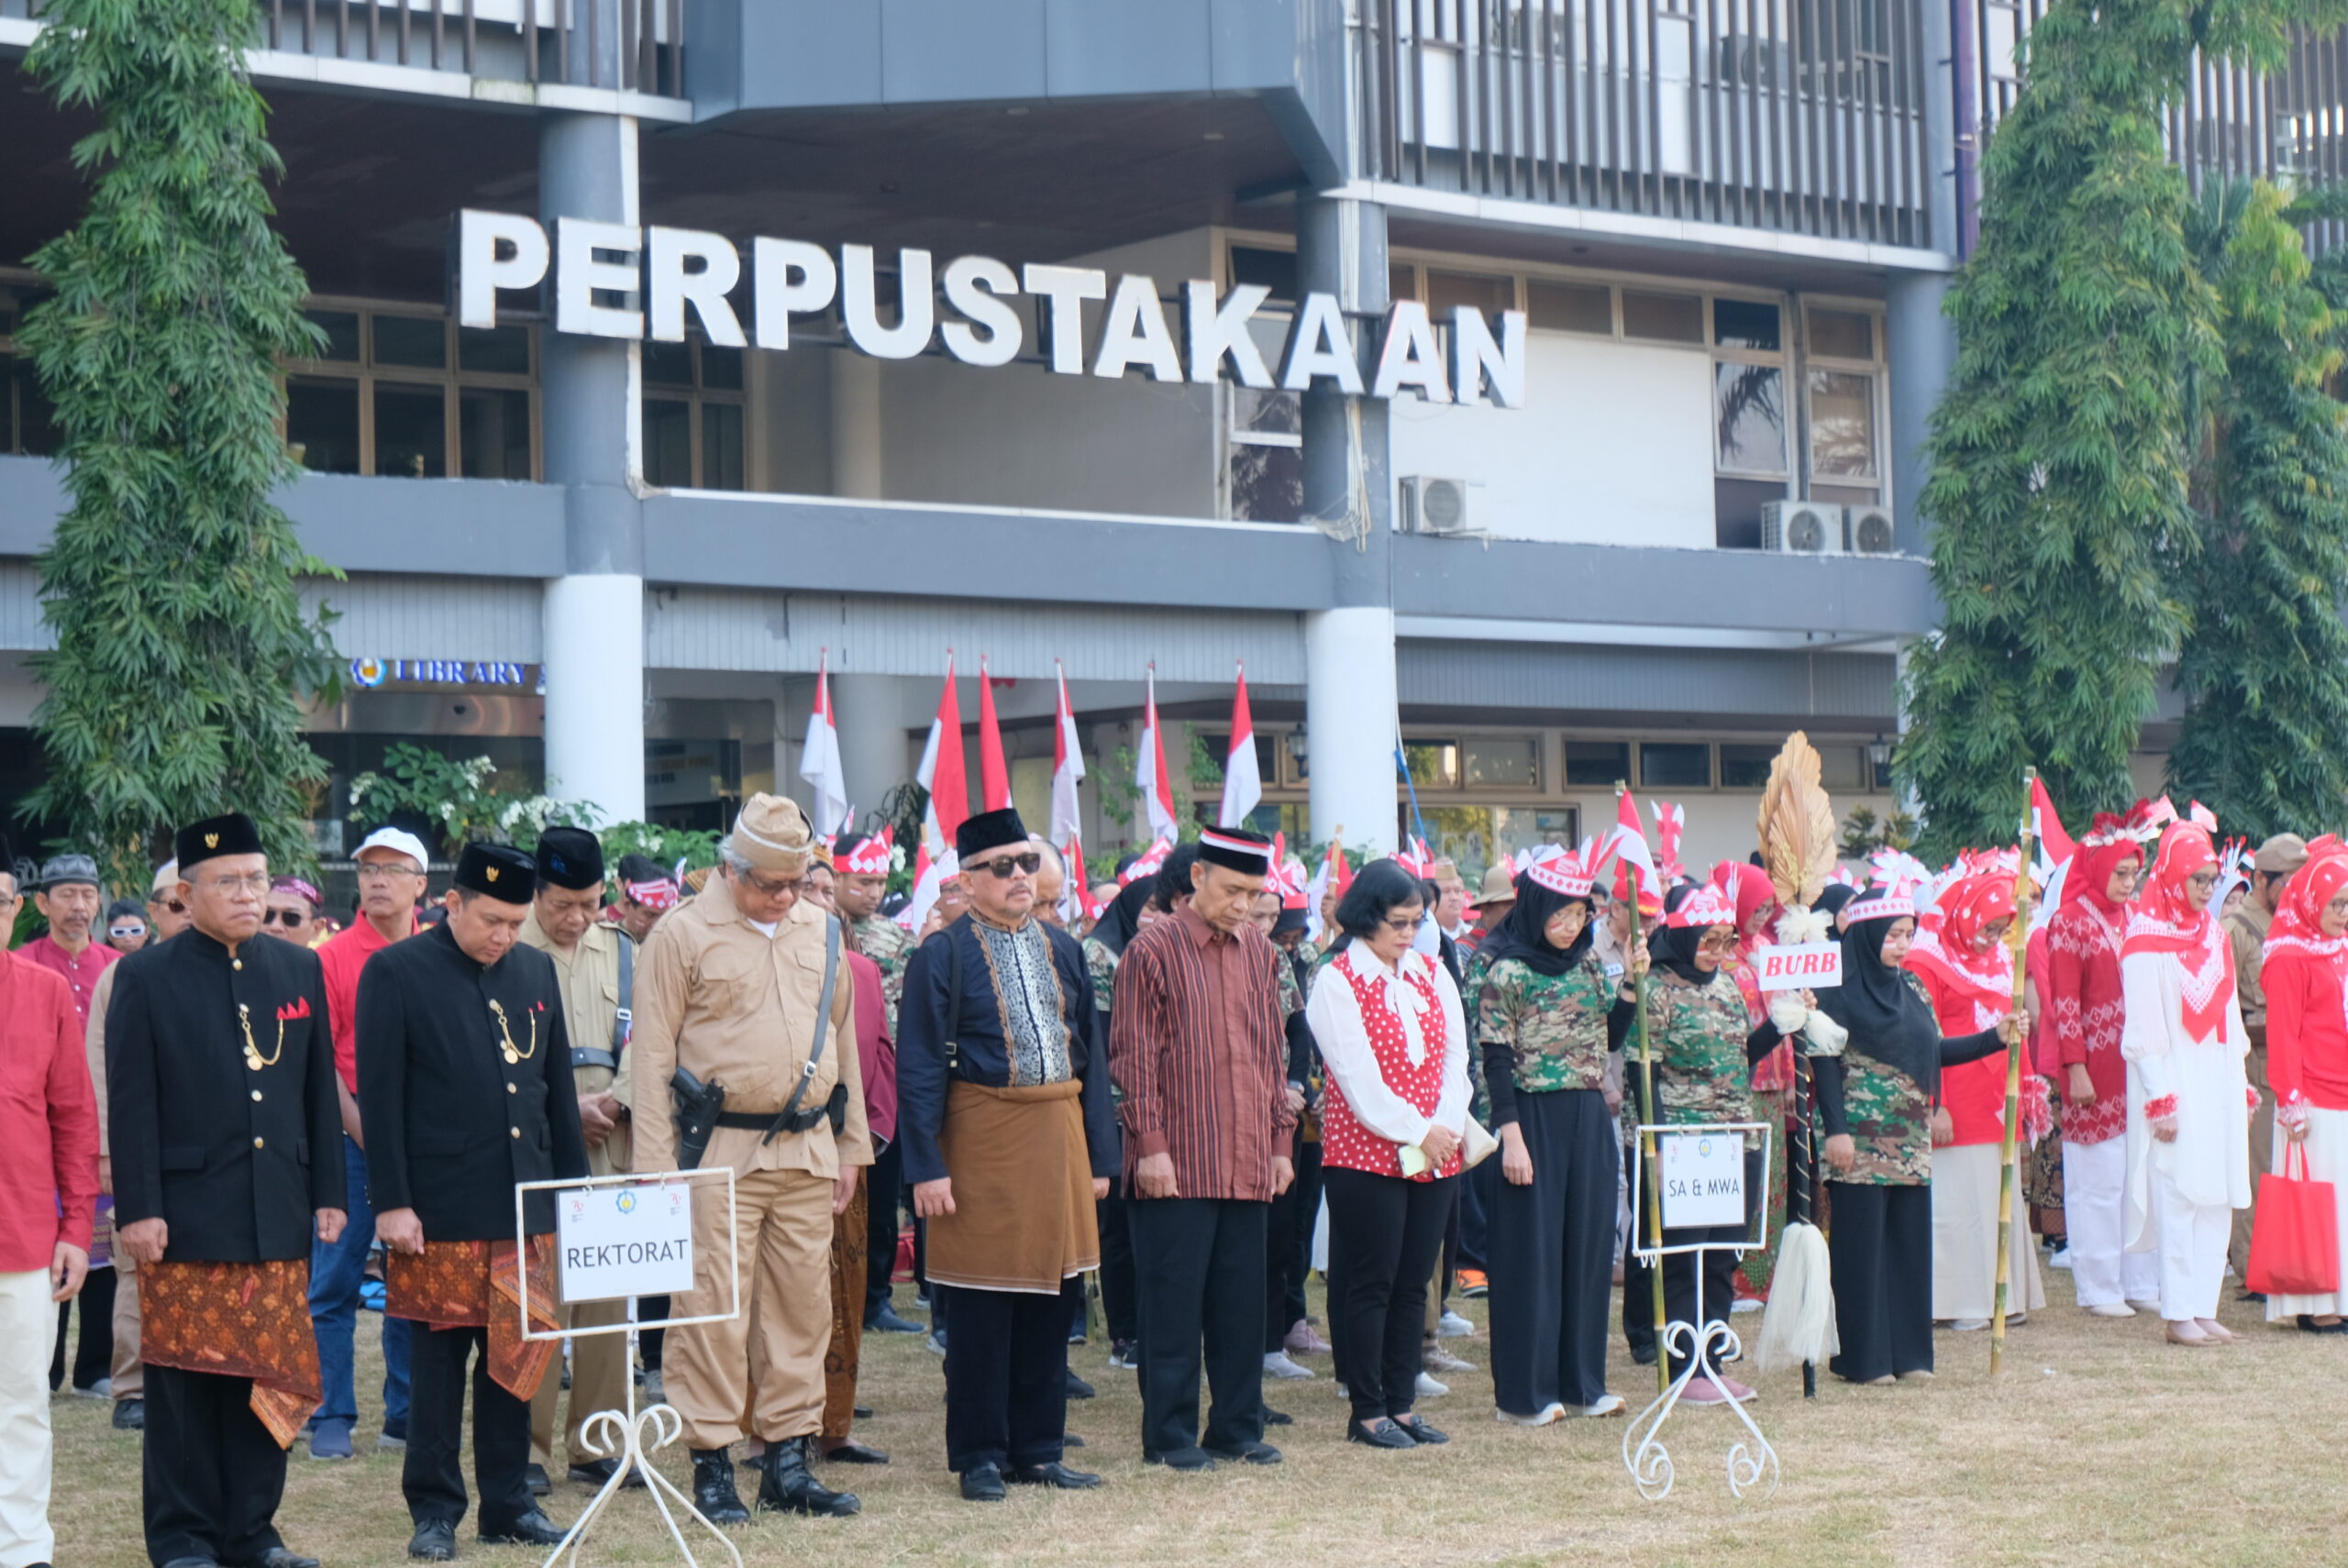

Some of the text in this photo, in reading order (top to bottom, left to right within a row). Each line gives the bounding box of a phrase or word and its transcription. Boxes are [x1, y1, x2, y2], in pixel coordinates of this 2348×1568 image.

[459, 208, 1527, 410] PERPUSTAKAAN
[395, 659, 526, 684] LIBRARY
[1765, 952, 1837, 977] BURB
[1668, 1177, 1740, 1197] SA & MWA
[567, 1239, 688, 1269] REKTORAT
